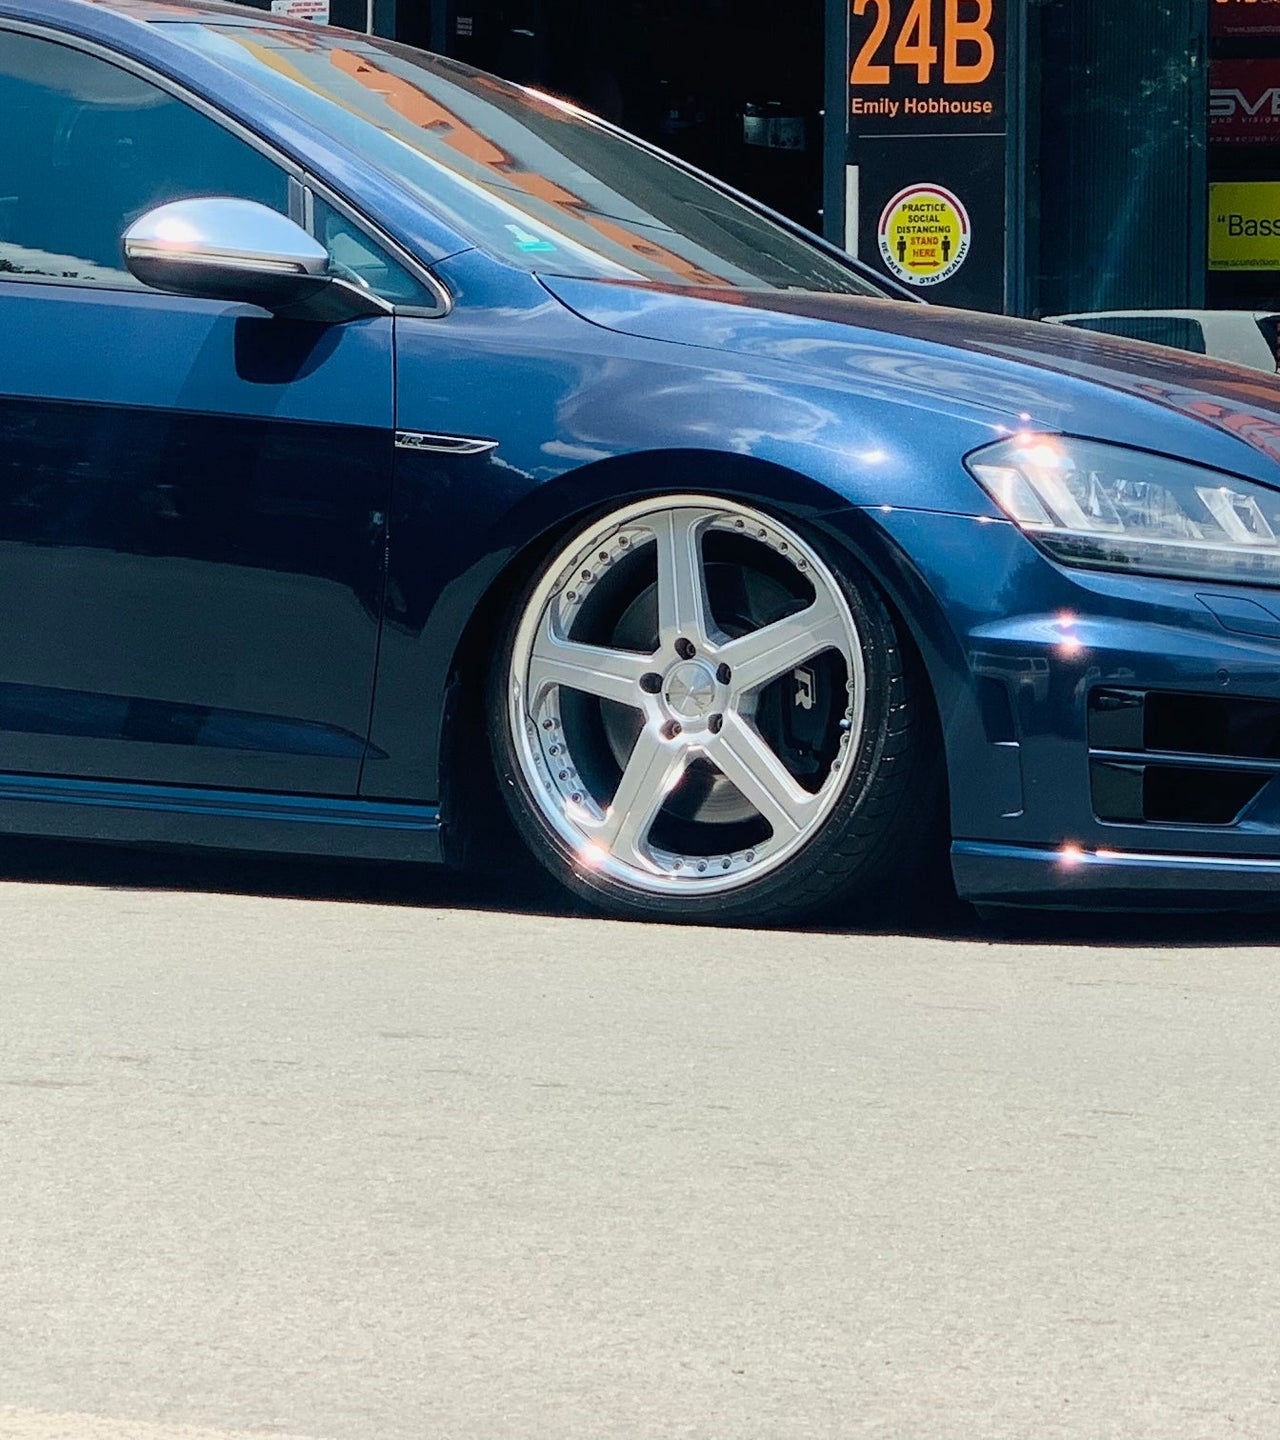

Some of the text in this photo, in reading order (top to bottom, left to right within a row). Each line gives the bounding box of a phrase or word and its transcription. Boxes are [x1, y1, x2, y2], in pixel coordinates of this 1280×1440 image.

[851, 97, 992, 118] Emily Hobhouse
[902, 203, 946, 212] PRACTICE
[908, 215, 940, 223] SOCIAL
[896, 226, 951, 234] DISTANCING
[910, 237, 939, 245] STAND
[913, 249, 936, 257] HERE
[942, 241, 968, 277] HEALTHY
